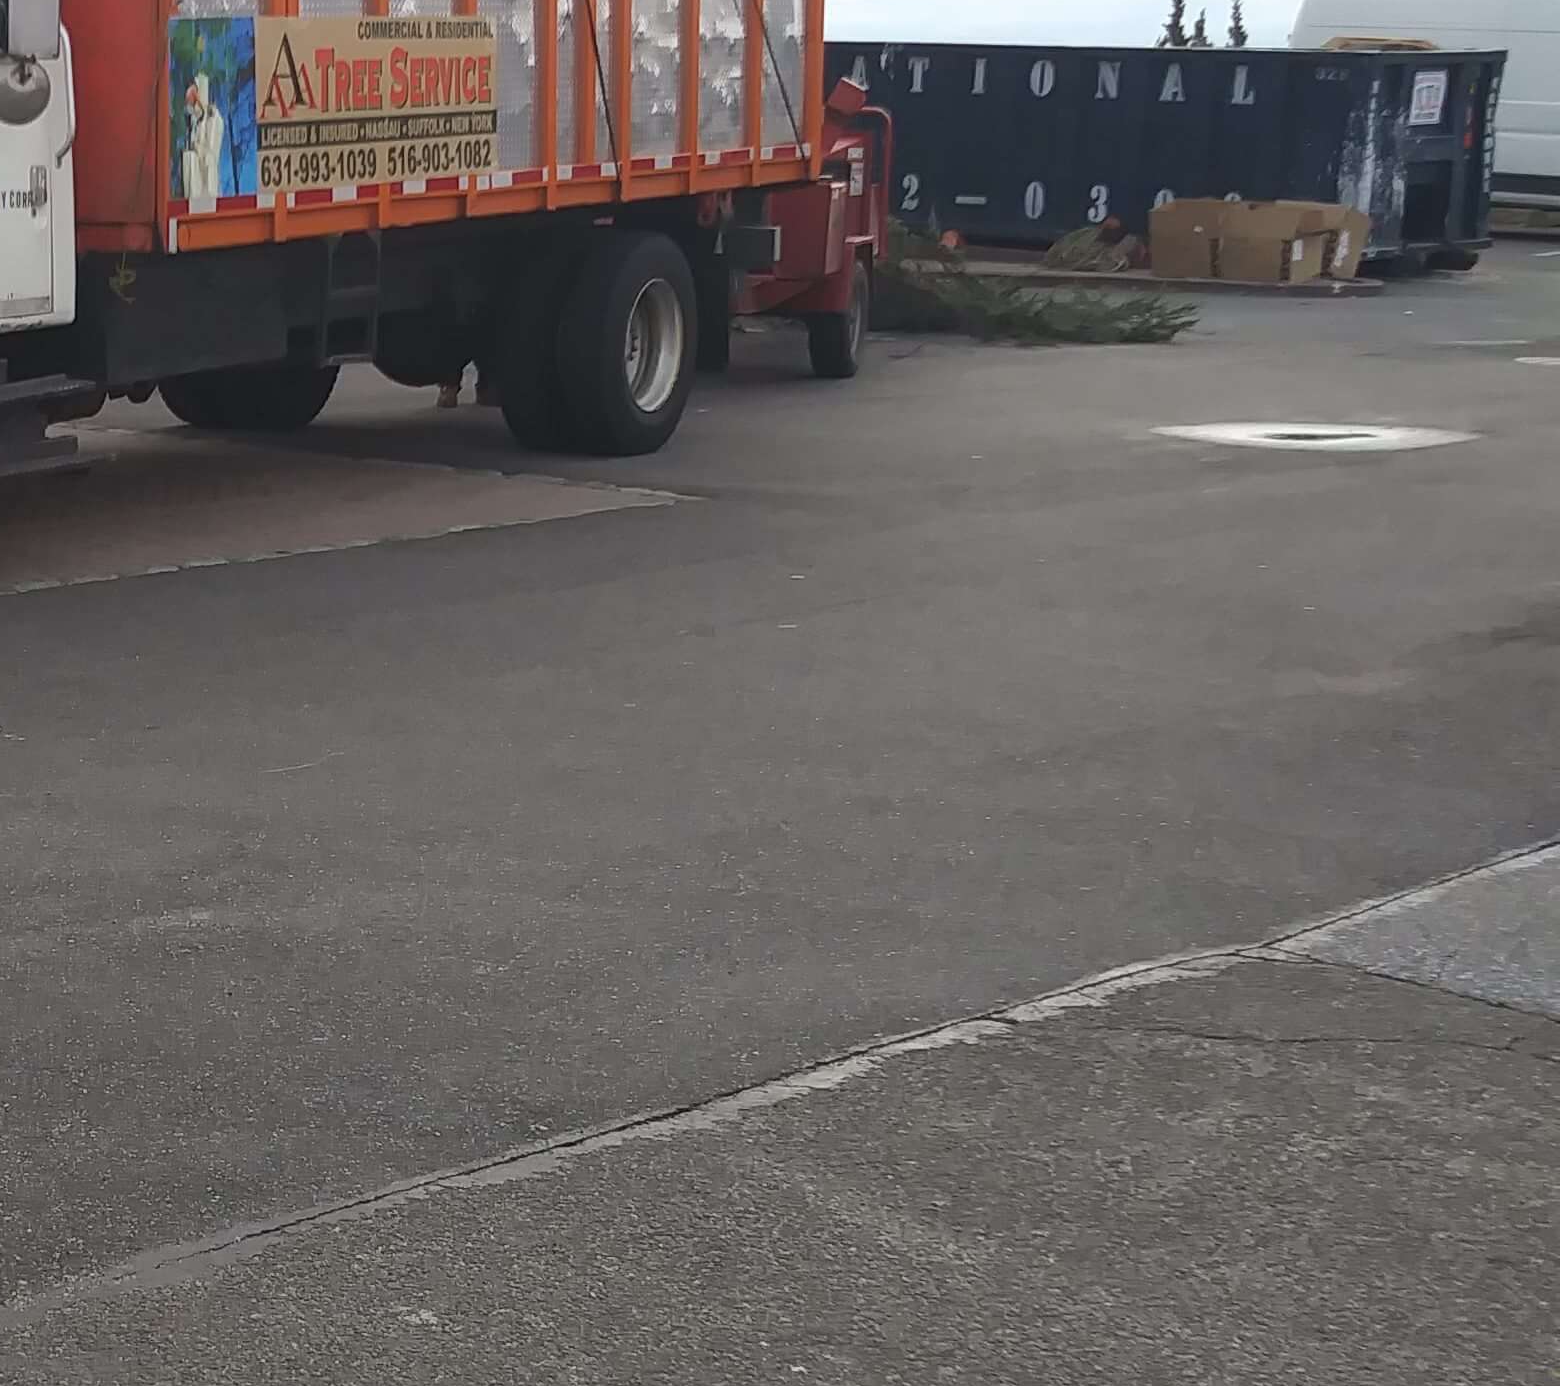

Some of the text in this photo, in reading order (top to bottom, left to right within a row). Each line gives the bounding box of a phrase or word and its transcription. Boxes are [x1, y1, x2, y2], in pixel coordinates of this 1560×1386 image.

[357, 20, 494, 41] COMMERCIAL & RESIDENTIAL
[261, 112, 493, 147] LICENSED & INSURED NASSAU SUFFOLK NEW YORK
[261, 139, 492, 187] 631-993-1039 516-903-1082
